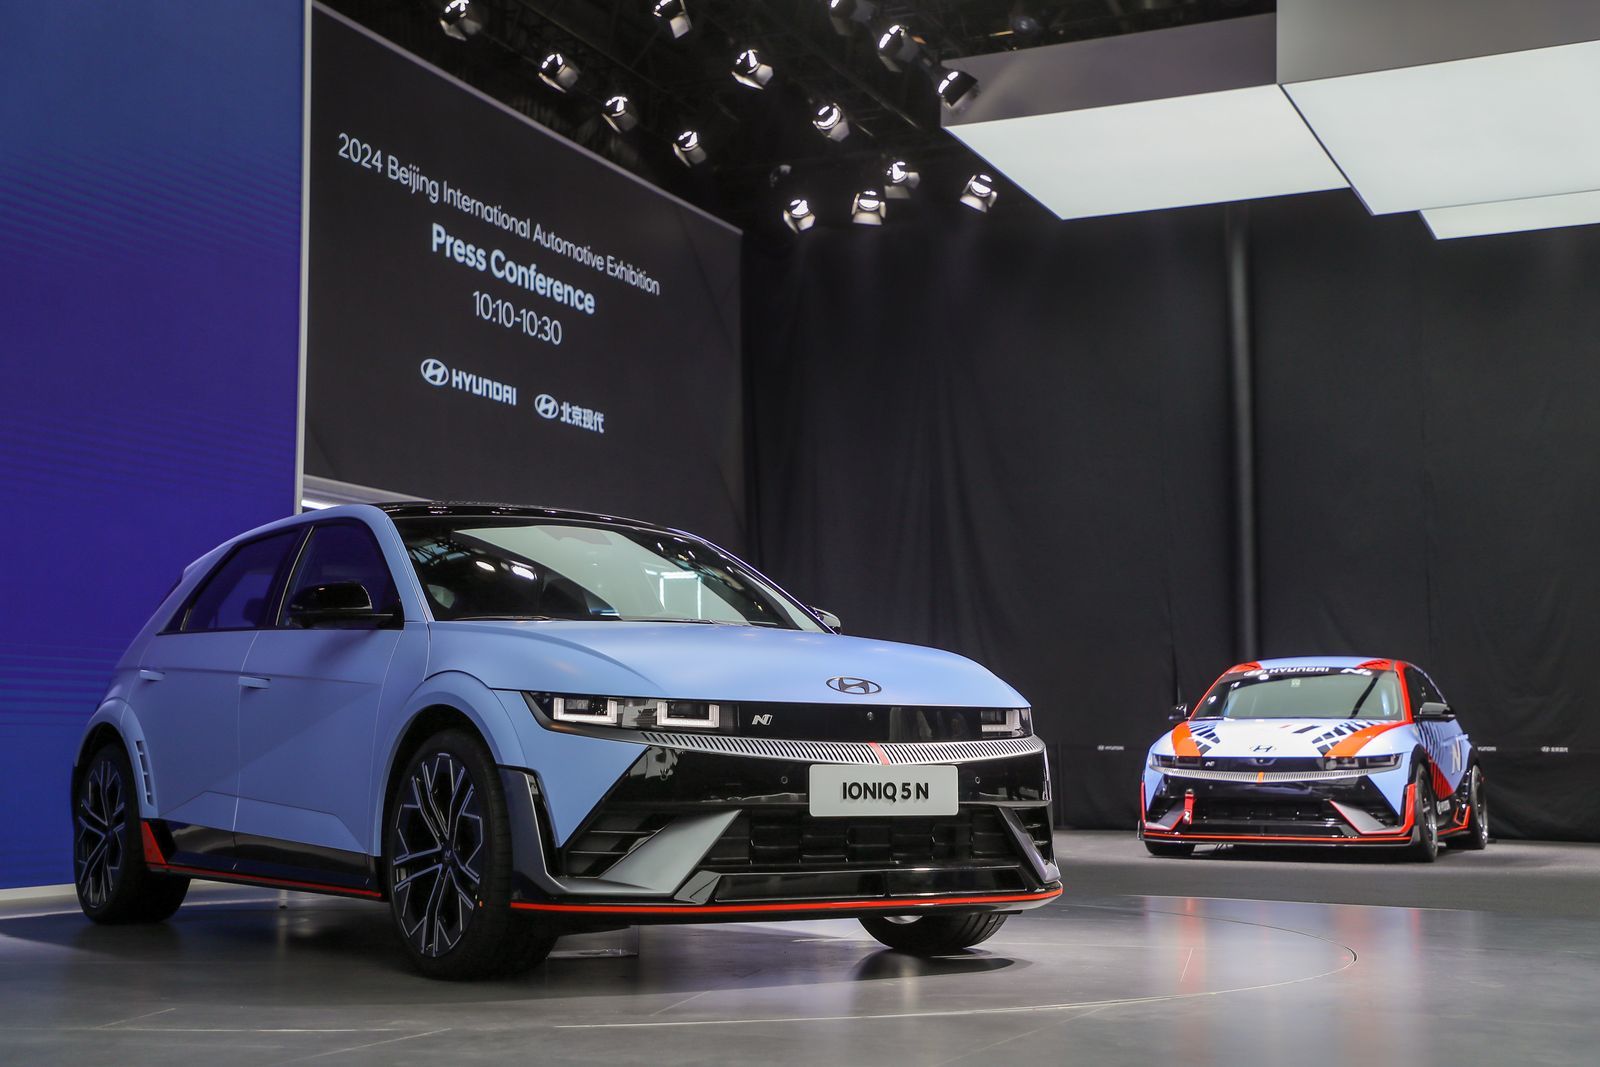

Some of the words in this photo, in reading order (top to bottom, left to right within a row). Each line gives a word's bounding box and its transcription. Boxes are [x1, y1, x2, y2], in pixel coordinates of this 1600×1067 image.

[338, 132, 383, 173] 2024
[387, 154, 439, 204] Beijing
[443, 180, 531, 240] International
[532, 223, 605, 272] Automotive
[606, 254, 661, 296] Exhibition
[432, 222, 487, 271] Press
[490, 248, 596, 315] Conference
[472, 290, 563, 346] 10:10-10:30
[451, 368, 517, 406] HYUNDAI
[560, 401, 605, 434] 北京现代
[1269, 666, 1330, 674] HYUNDAI
[842, 782, 897, 803] IONIQ
[900, 782, 912, 800] 5
[915, 782, 930, 800] N
